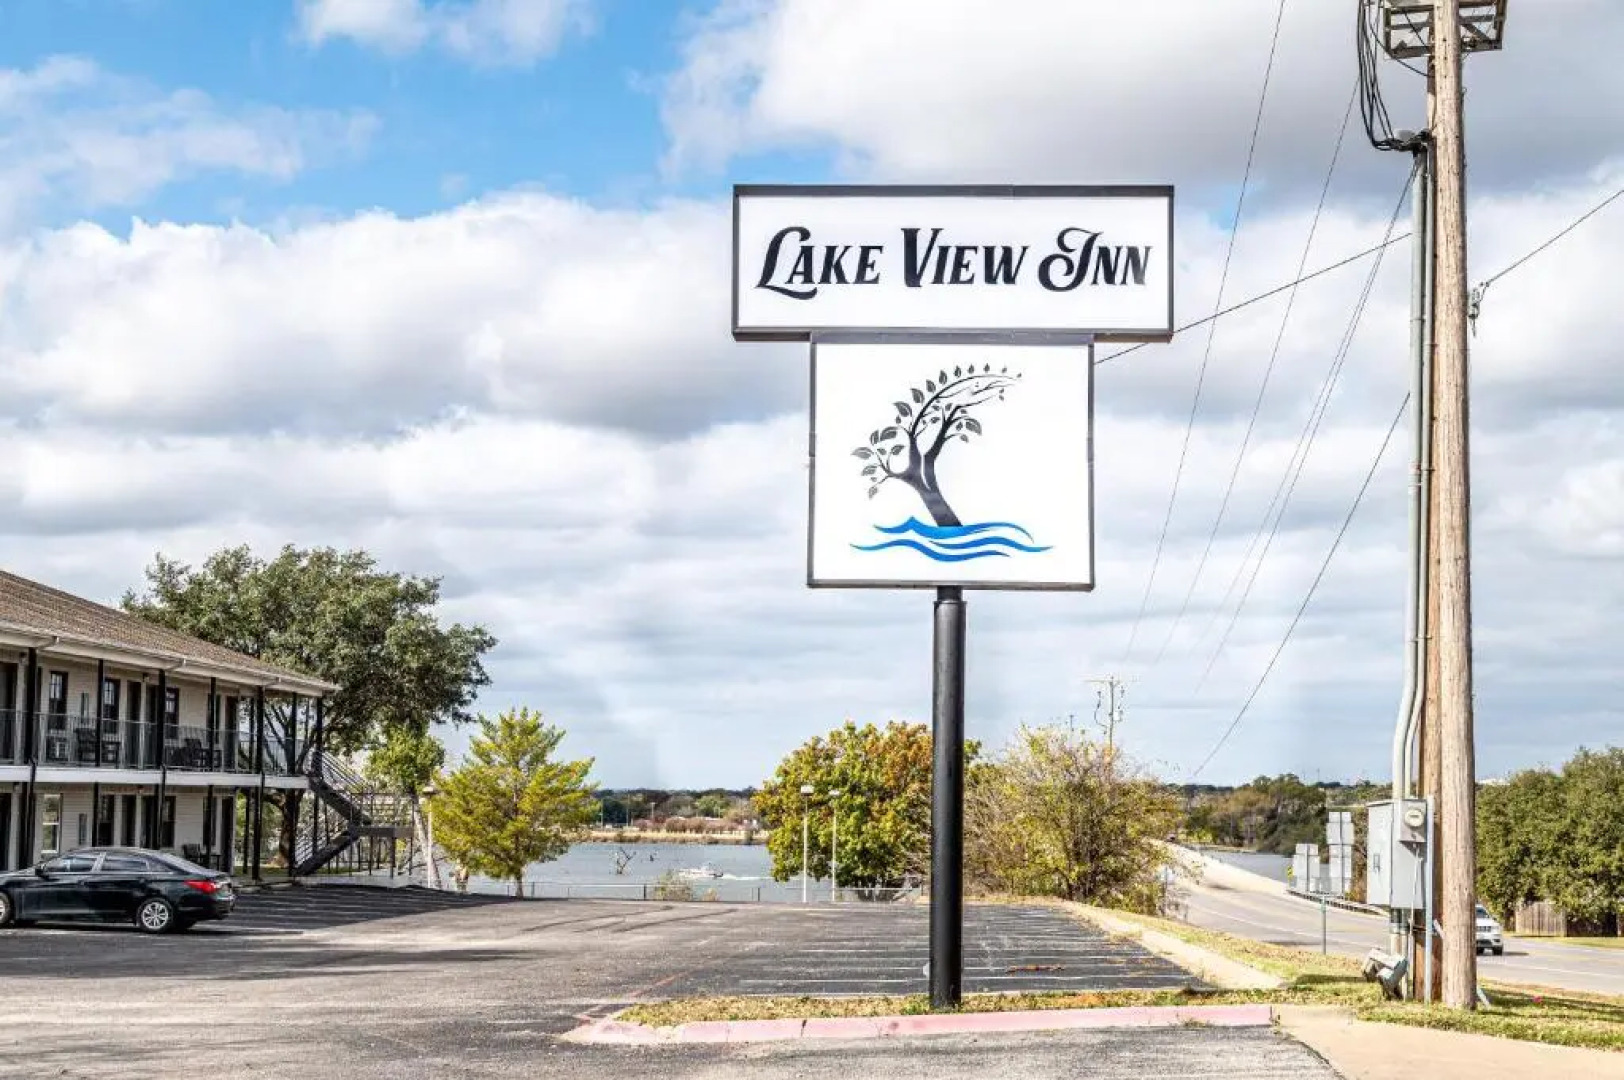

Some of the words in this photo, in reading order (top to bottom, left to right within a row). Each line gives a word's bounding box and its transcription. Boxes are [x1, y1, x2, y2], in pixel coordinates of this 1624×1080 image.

[756, 227, 883, 300] LAKE
[901, 228, 1028, 287] VIEW
[1039, 228, 1150, 292] INN
